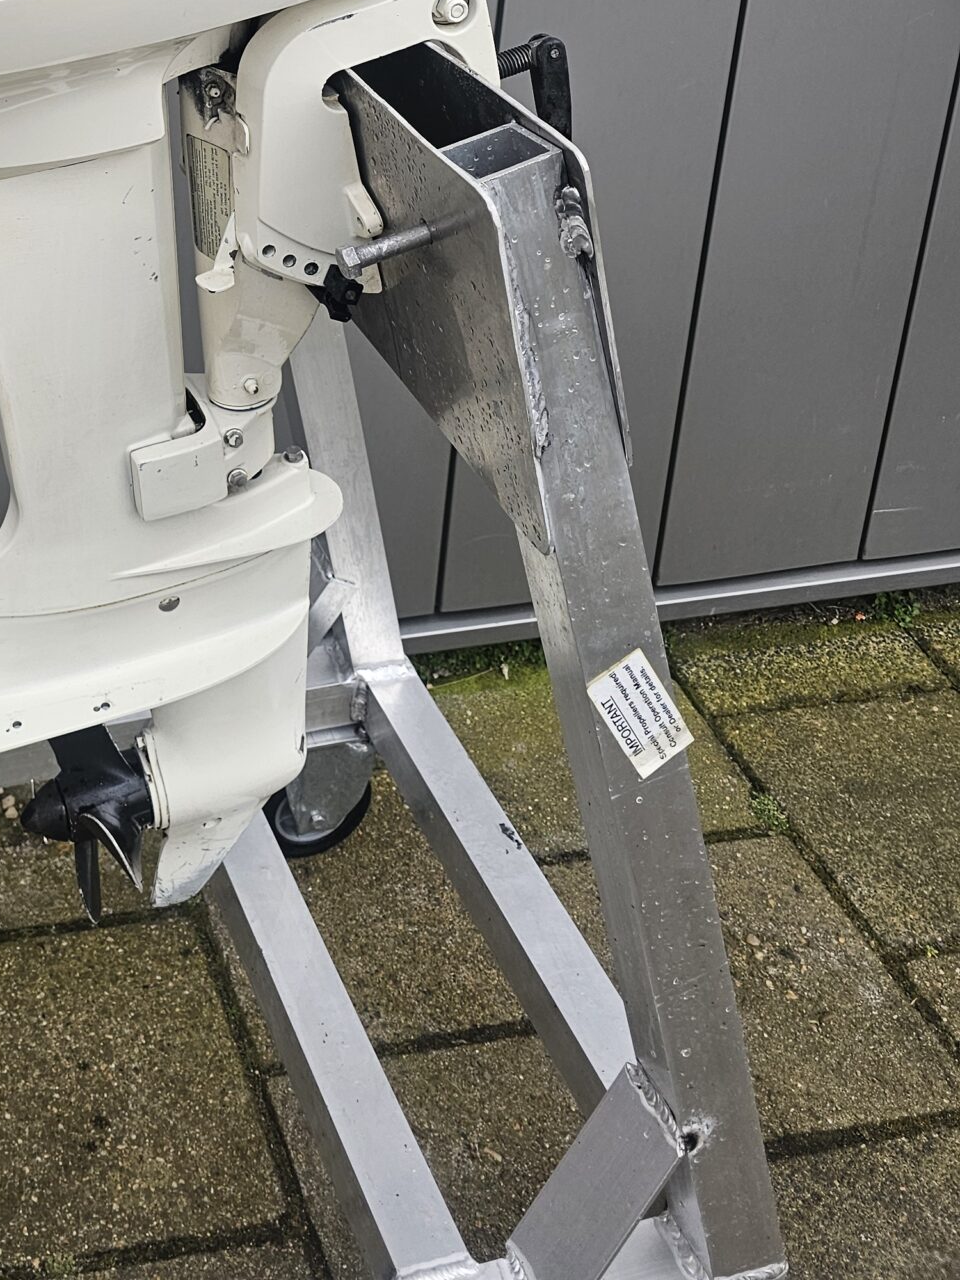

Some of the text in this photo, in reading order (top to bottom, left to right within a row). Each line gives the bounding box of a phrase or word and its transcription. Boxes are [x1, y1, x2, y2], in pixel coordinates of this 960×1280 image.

[639, 666, 656, 691] details.
[622, 663, 676, 747] Consult Operation Manual
[653, 691, 662, 702] for
[628, 701, 651, 735] Propellers
[659, 702, 676, 725] Dealer
[600, 698, 644, 756] IMPORTANT
[647, 734, 666, 759] Special
